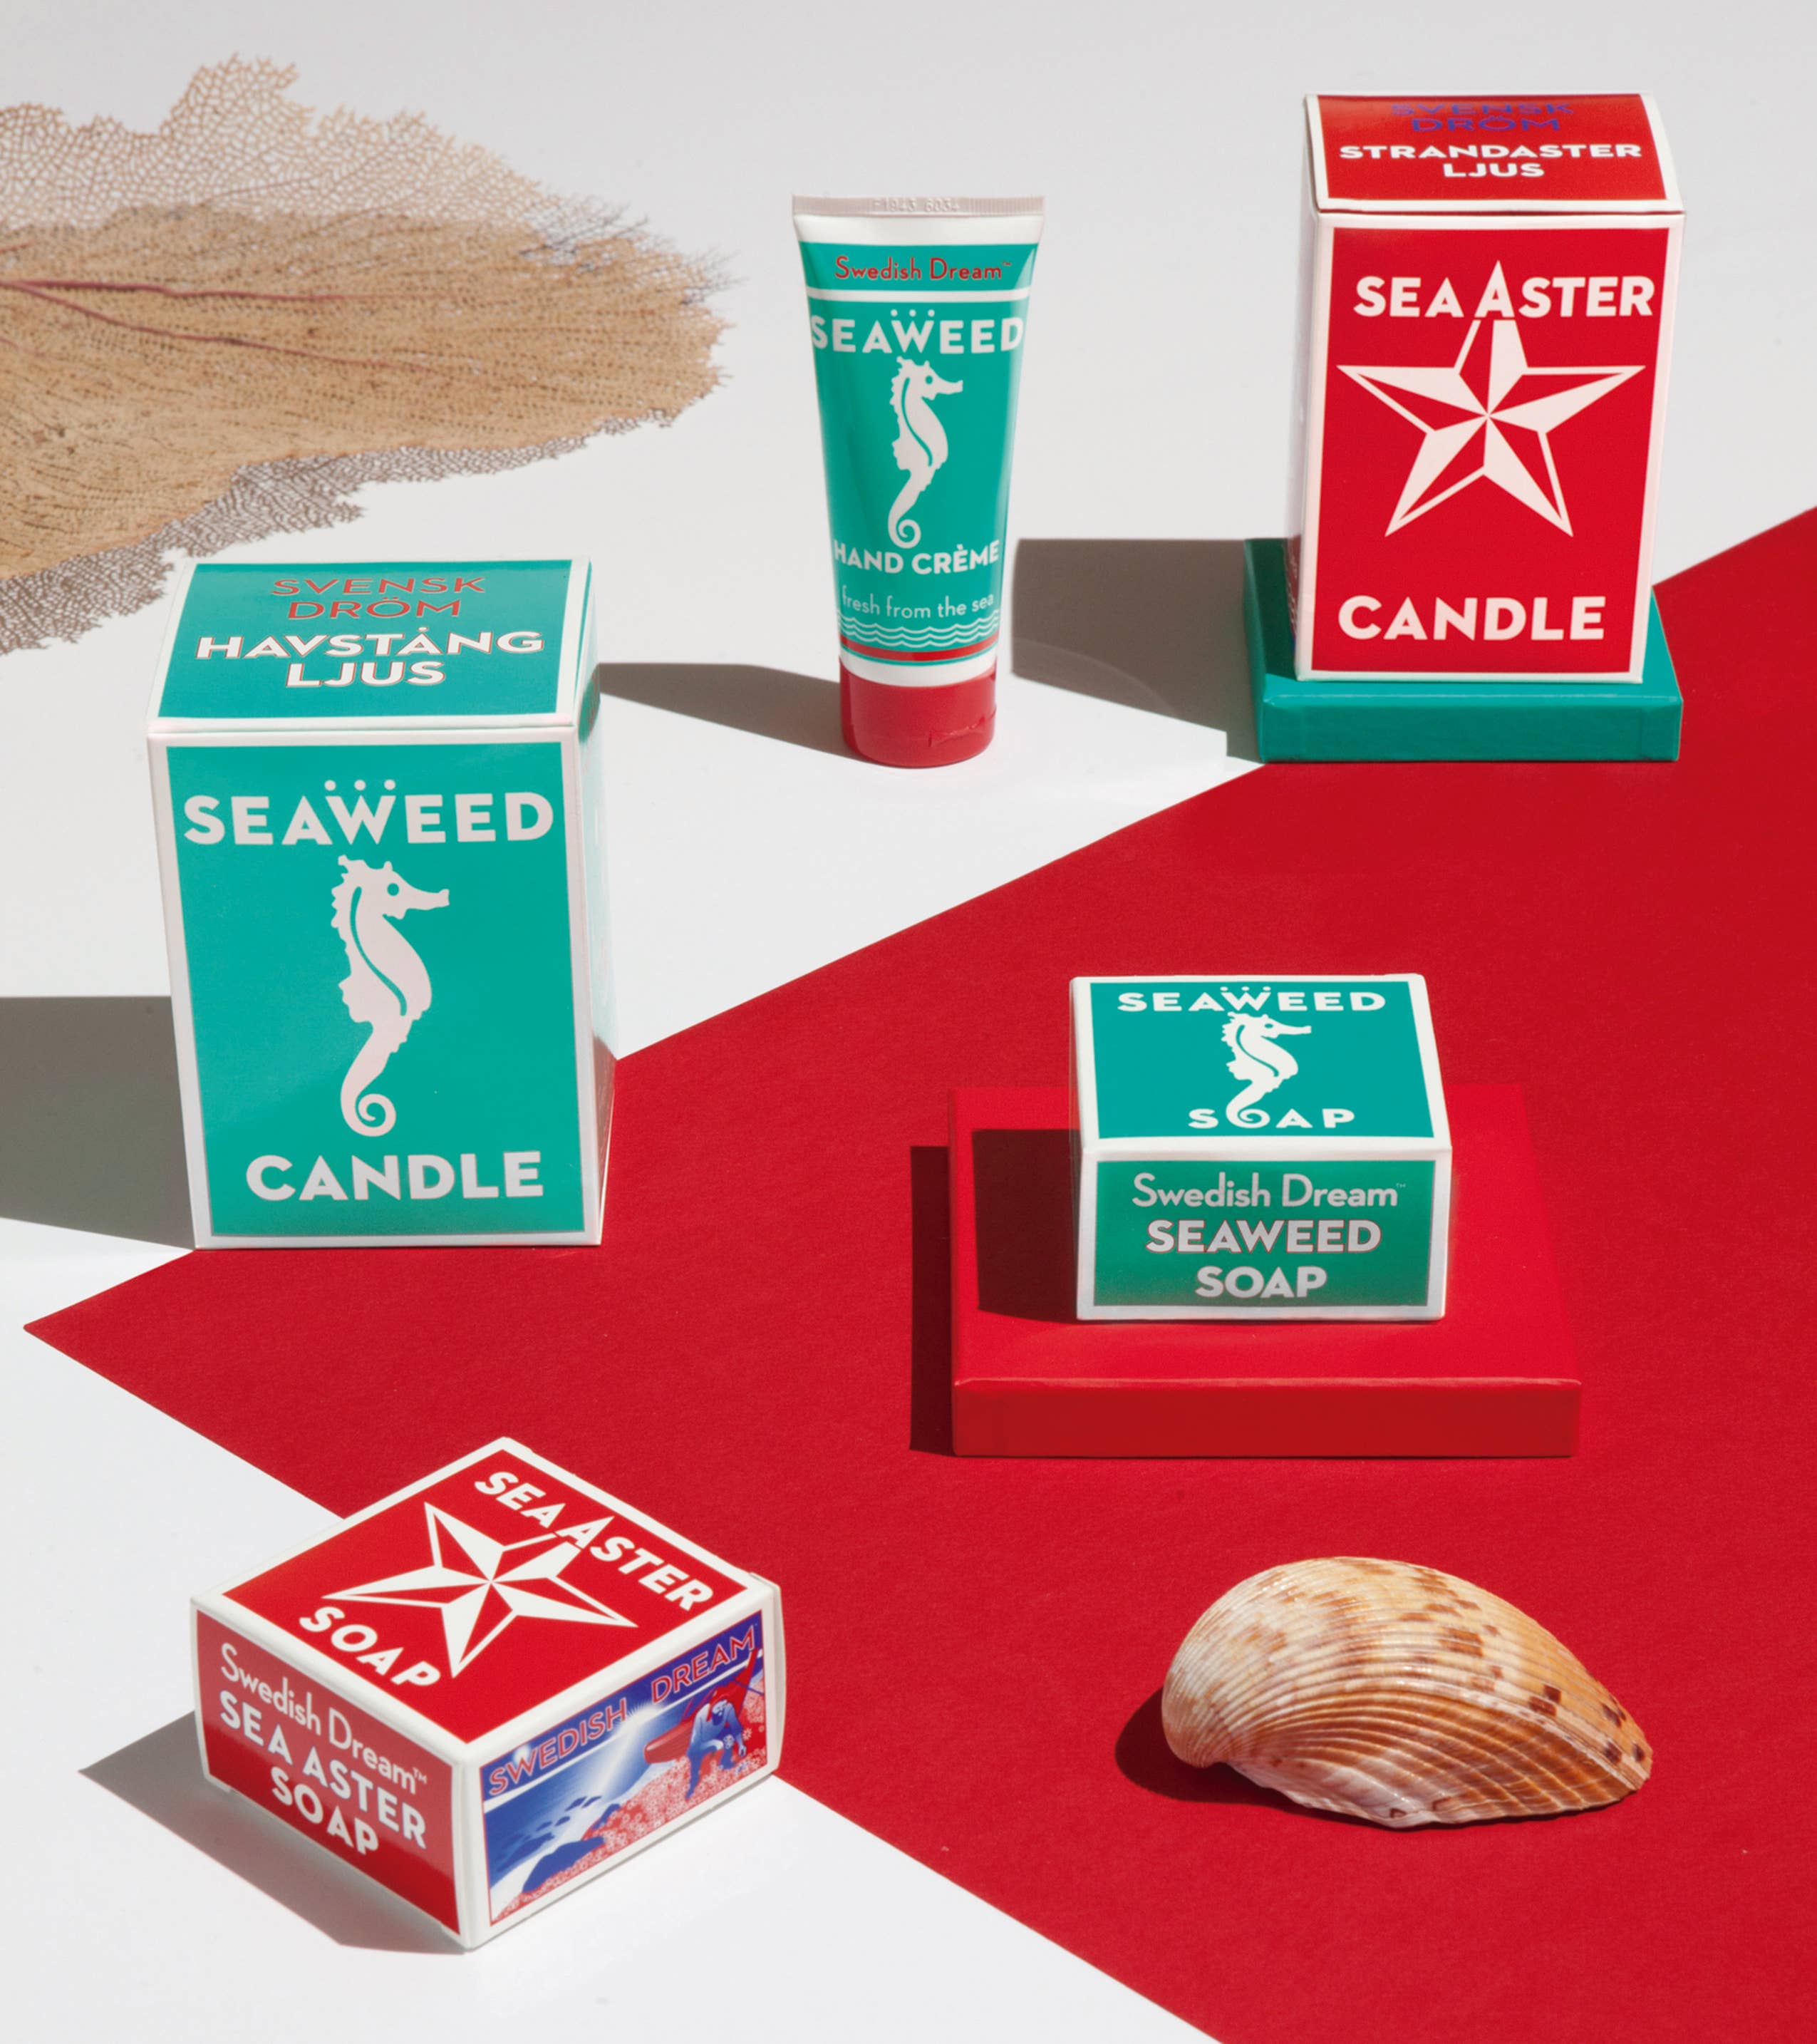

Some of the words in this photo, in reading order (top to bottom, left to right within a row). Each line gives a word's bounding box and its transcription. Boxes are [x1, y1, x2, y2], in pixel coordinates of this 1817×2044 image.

[1391, 103, 1574, 115] SVENSK
[1411, 115, 1560, 132] DRÖM
[1340, 143, 1642, 159] STRANDASTER
[1442, 162, 1545, 178] LJUS
[834, 255, 922, 281] Swedish
[1353, 275, 1465, 318] SEA
[1474, 259, 1656, 319] ASTER
[809, 309, 1024, 354] SEAWEED
[833, 539, 904, 574] HAND
[911, 539, 1000, 575] CRÈME
[270, 576, 487, 597] SVENSK
[842, 584, 881, 616] fresh
[886, 594, 931, 619] from
[937, 595, 967, 618] the
[971, 593, 995, 612] sea
[286, 596, 462, 620] DRÖM
[1337, 594, 1607, 641] CANDLE
[195, 626, 546, 660] HAVSTÅNG
[285, 660, 447, 688] LJUS
[183, 780, 554, 847] SEAWEED
[1117, 986, 1387, 1013] SEAWEED
[245, 1150, 544, 1202] CANDLE
[1131, 1171, 1271, 1208] Swedish
[1145, 1219, 1383, 1254] SEAWEED
[1194, 1265, 1328, 1299] SOAP
[473, 1470, 567, 1529] SEA
[553, 1515, 715, 1612] ASTER
[299, 1605, 441, 1686] SOAP
[220, 1641, 322, 1736] Swedish
[488, 1696, 628, 1796] SWEDISH
[219, 1689, 294, 1766] SEA
[301, 1745, 428, 1850] ASTER
[270, 1765, 379, 1855] SOAP
